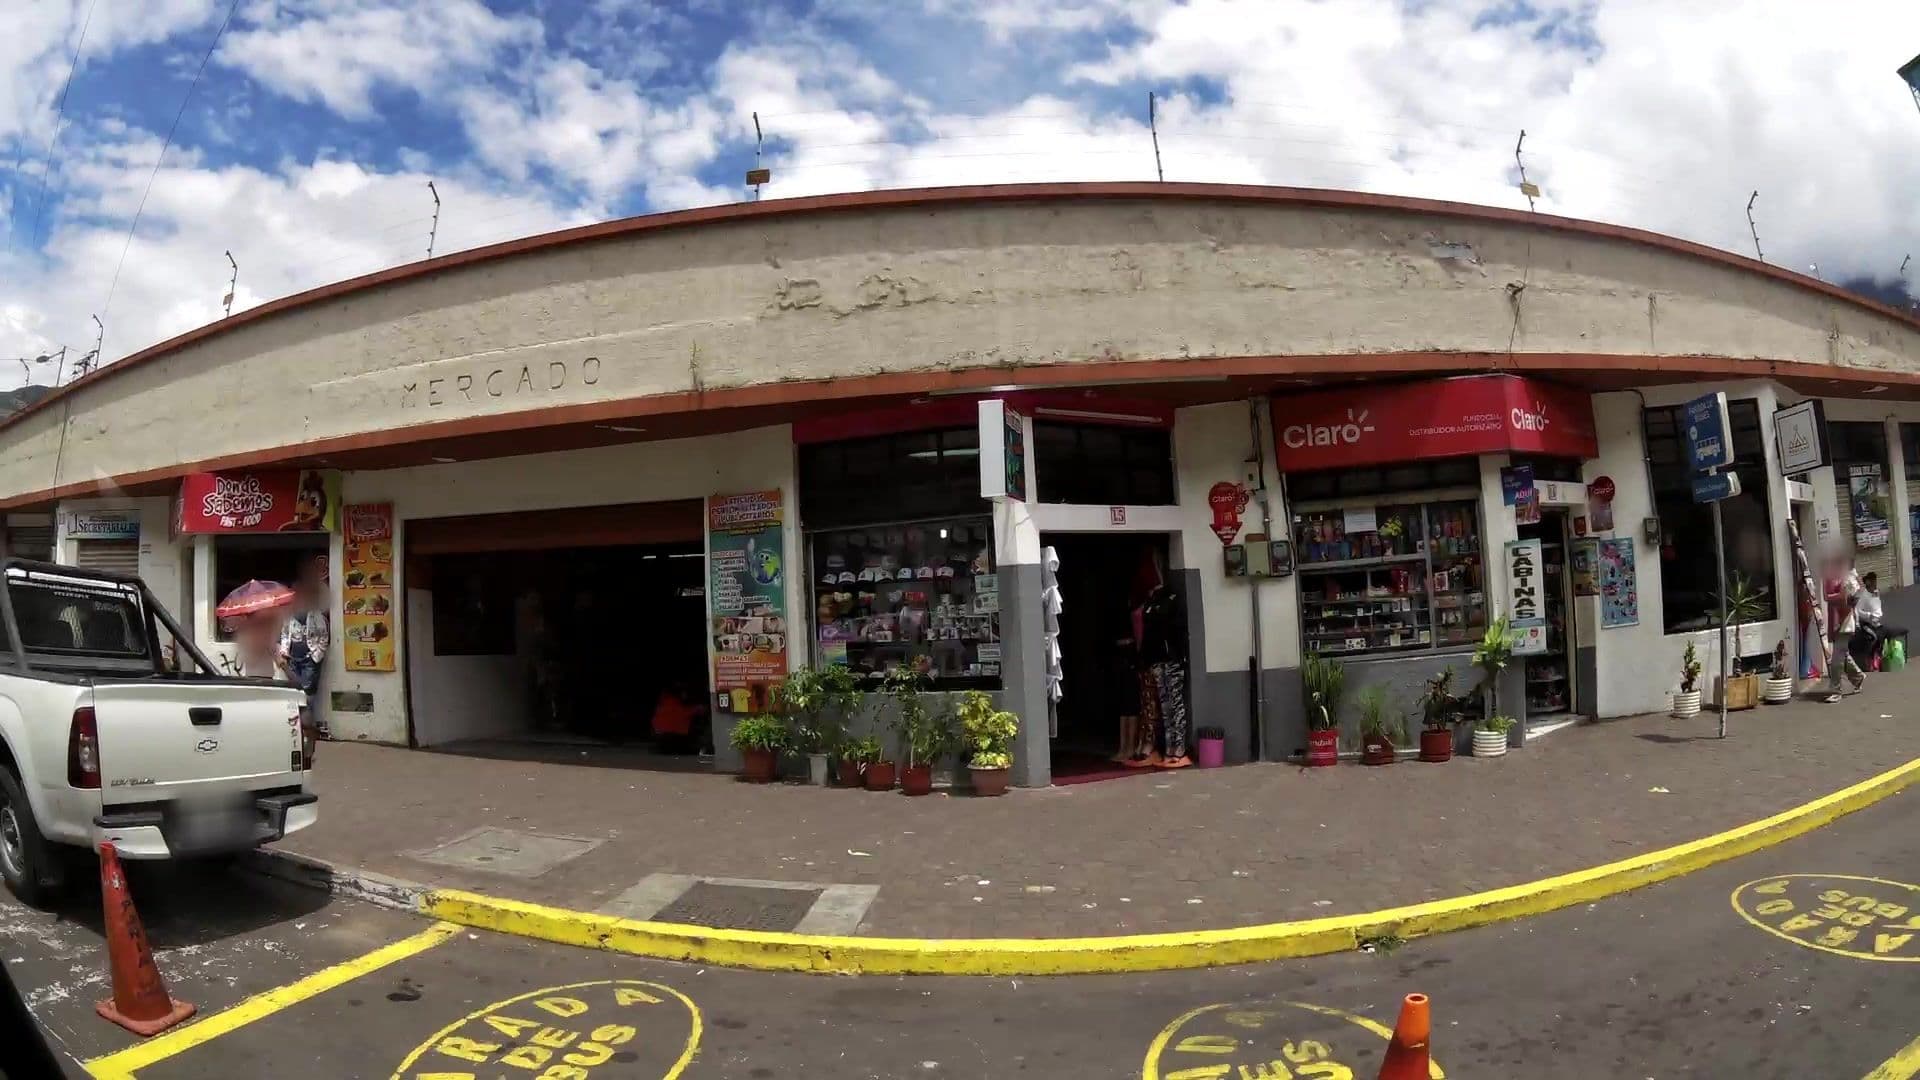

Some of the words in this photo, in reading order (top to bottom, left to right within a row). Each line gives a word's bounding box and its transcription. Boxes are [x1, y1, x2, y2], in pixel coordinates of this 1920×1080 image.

[402, 357, 601, 408] MERCADO
[1283, 418, 1366, 448] Claro
[1511, 405, 1546, 432] Claro
[216, 476, 260, 496] Donde
[203, 493, 273, 516] Sabemos
[1512, 546, 1536, 619] CABINAS
[501, 1027, 581, 1070] DE
